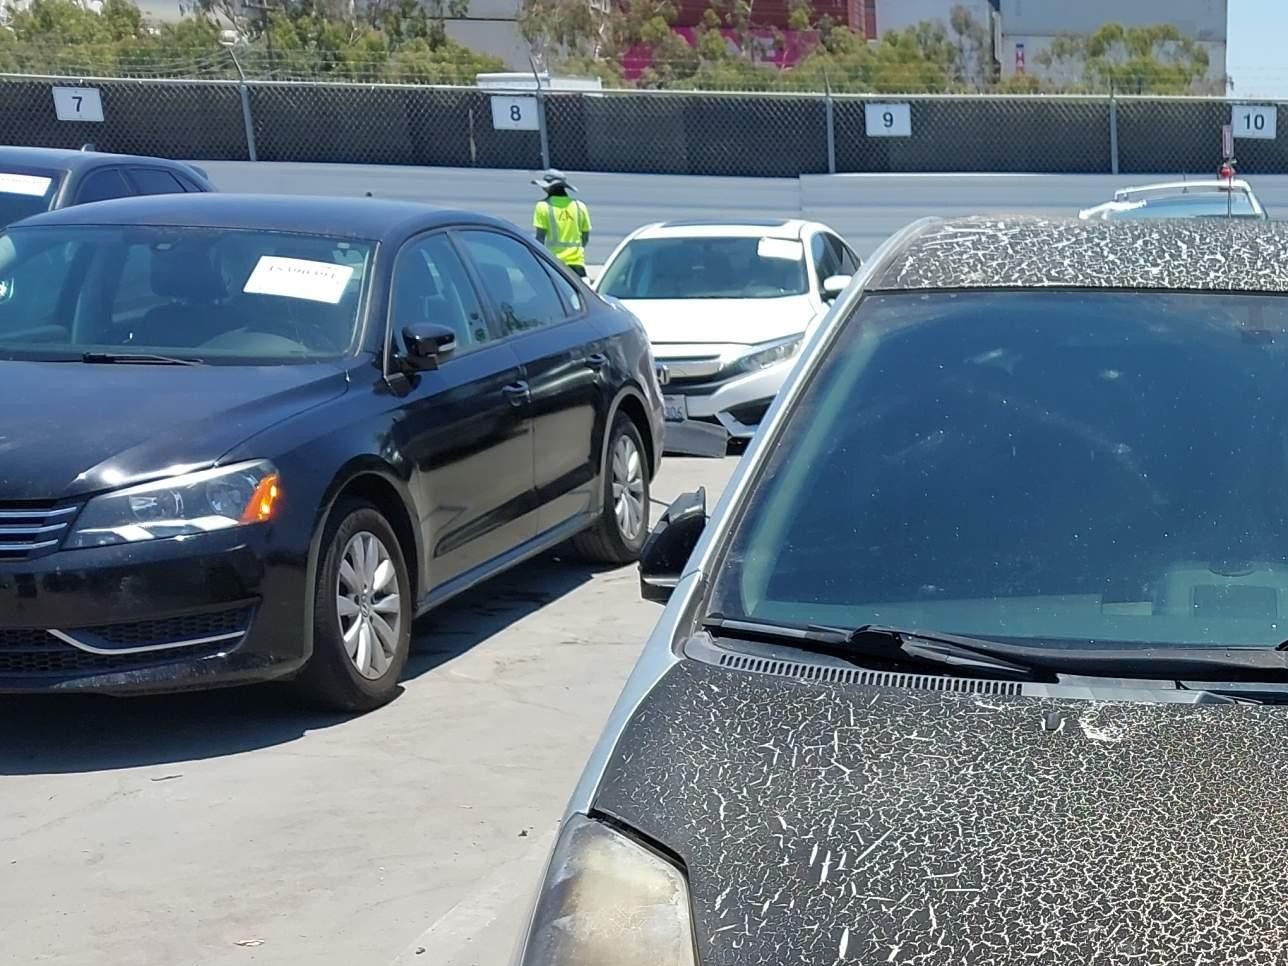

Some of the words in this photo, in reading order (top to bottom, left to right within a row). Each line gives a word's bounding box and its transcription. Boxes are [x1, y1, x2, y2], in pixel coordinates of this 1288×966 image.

[72, 96, 83, 112] 7
[510, 105, 521, 121] 8
[883, 112, 894, 128] 9
[1243, 113, 1265, 130] 10
